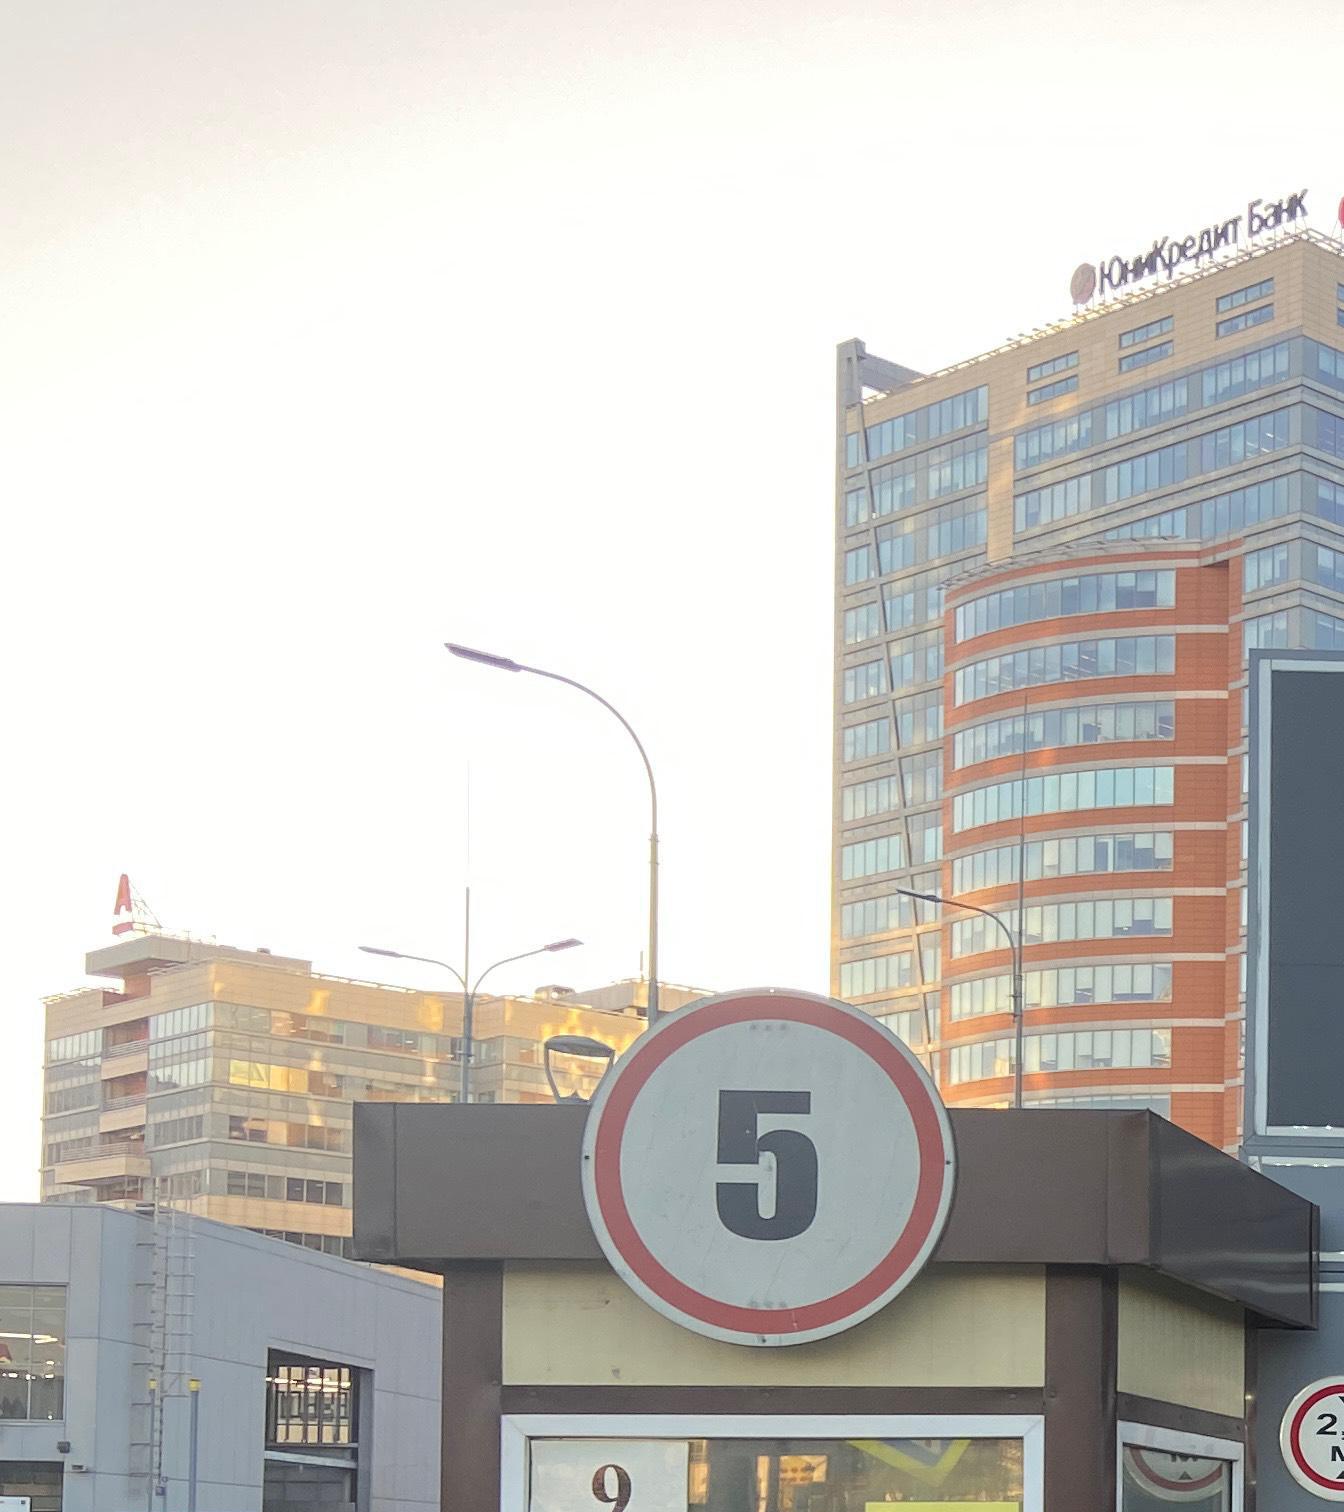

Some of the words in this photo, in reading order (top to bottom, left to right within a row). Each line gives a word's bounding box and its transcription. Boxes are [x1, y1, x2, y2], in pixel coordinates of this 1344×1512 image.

[1098, 215, 1242, 296] ЮниКредит
[1247, 188, 1308, 238] Банк
[715, 1088, 820, 1242] 5
